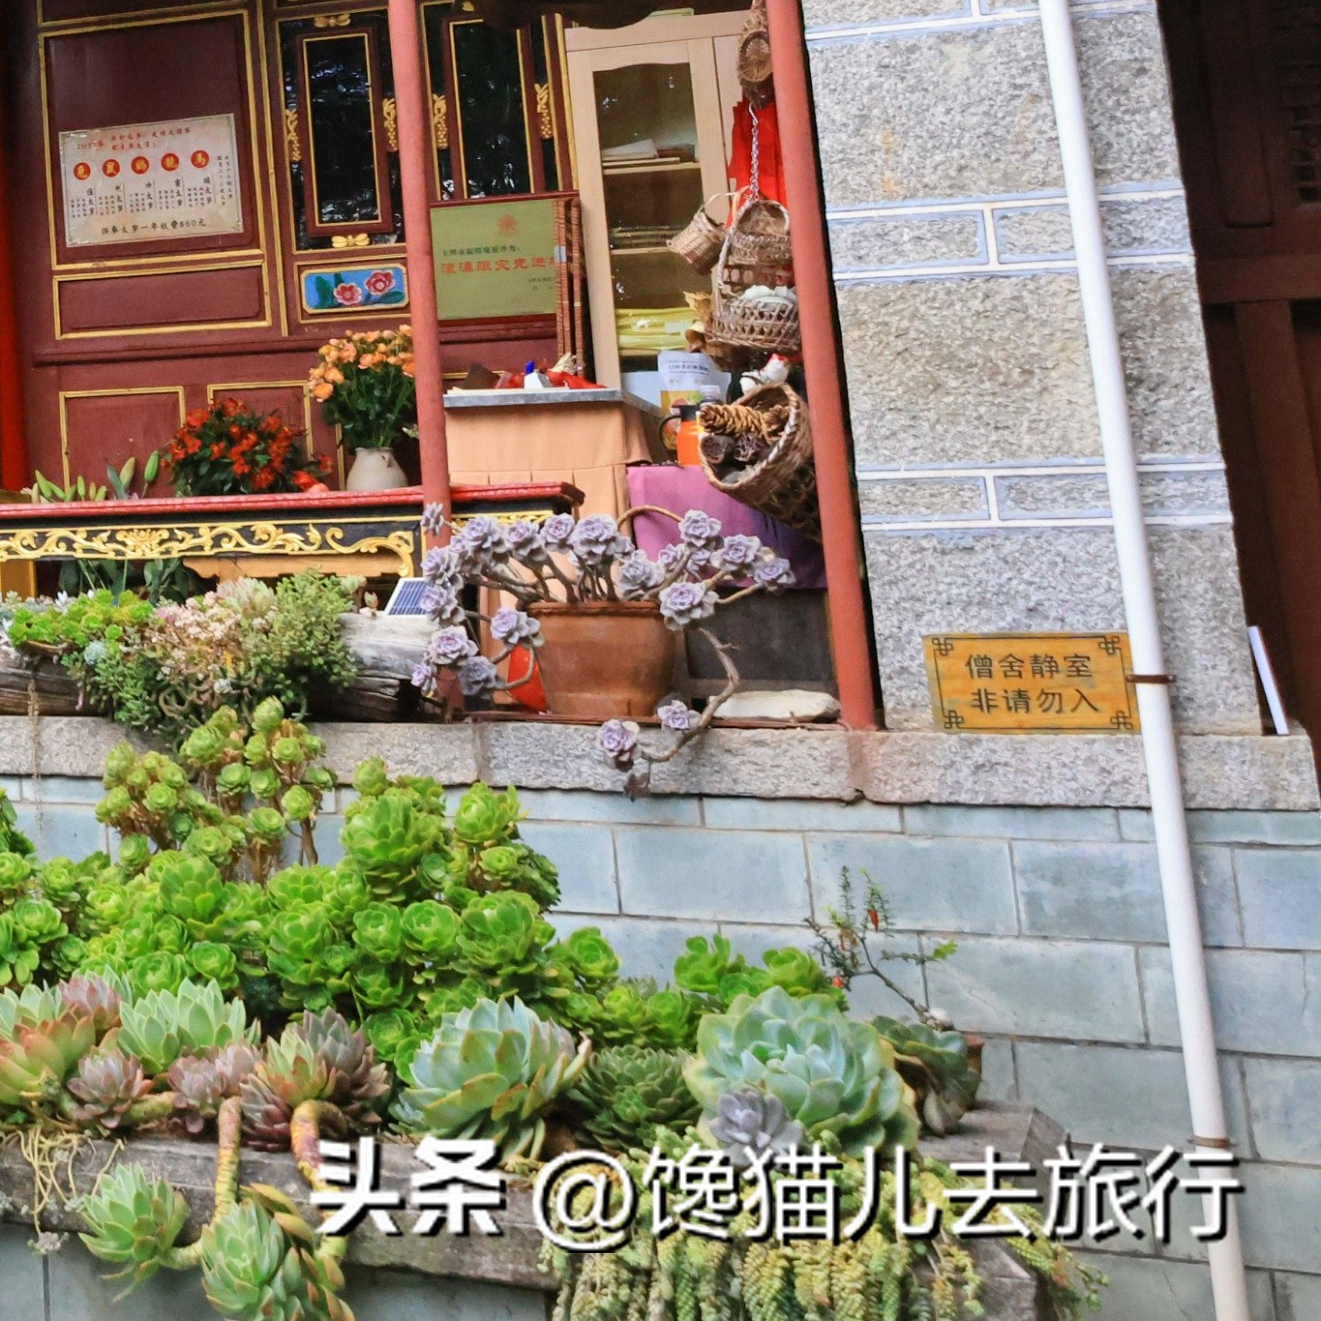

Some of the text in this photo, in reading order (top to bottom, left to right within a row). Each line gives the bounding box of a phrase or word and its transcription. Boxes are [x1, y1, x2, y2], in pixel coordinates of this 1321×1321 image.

[964, 653, 1093, 682] 僧舍静室
[971, 688, 1101, 716] 非请勿入
